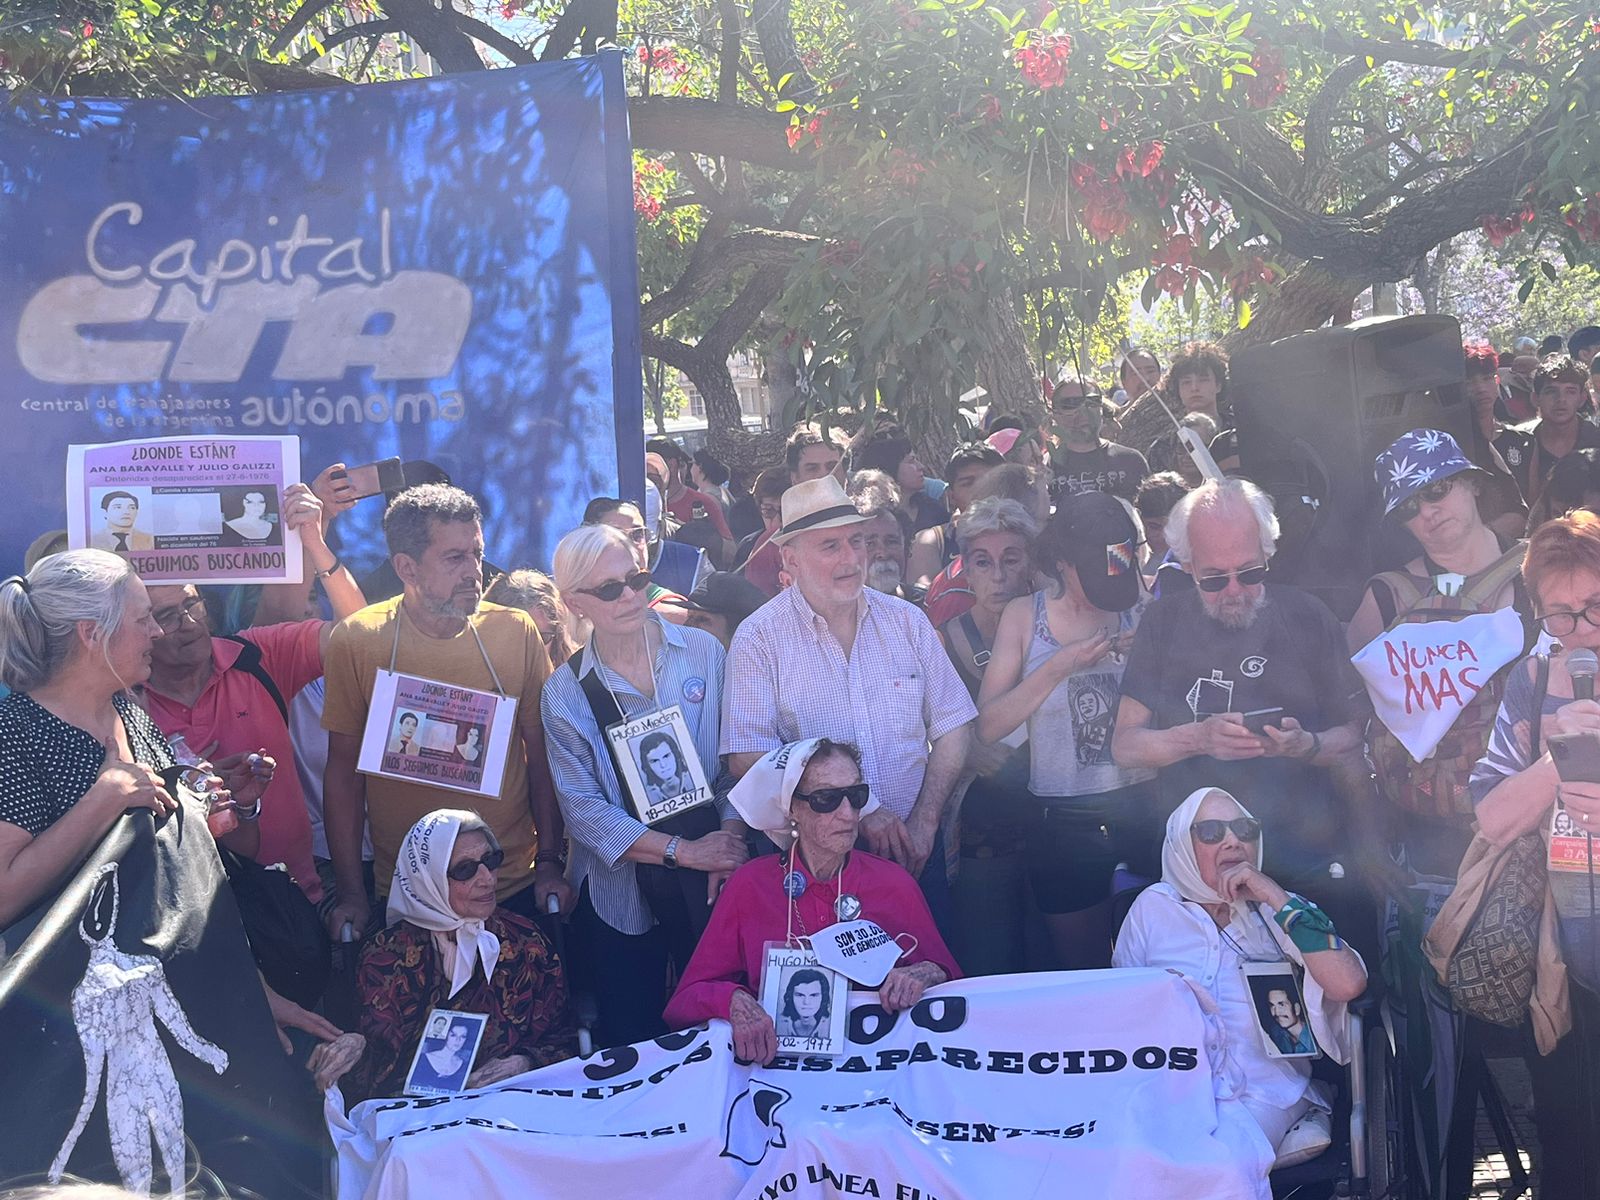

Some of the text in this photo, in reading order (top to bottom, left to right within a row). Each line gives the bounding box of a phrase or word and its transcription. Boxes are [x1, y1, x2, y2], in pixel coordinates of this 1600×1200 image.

[86, 201, 391, 304] Capital
[16, 270, 473, 384] CTA
[21, 398, 89, 412] central
[96, 397, 117, 409] de
[240, 387, 465, 428] autónoma
[105, 414, 125, 427] de
[131, 442, 236, 461] ¿DONDE ESTÁN?
[120, 464, 184, 473] BARAVALLE
[198, 463, 229, 471] JULIO
[130, 554, 200, 574] SEGUIMOS
[1383, 639, 1478, 677] NUNCA
[1404, 667, 1482, 714] MAS
[611, 726, 640, 742] Hugo
[645, 787, 705, 821] 18-02-1977
[834, 930, 856, 948] SON
[768, 954, 801, 968] HUGO
[841, 945, 858, 958] FUE
[728, 1042, 1198, 1074] ESAPARECIDOS
